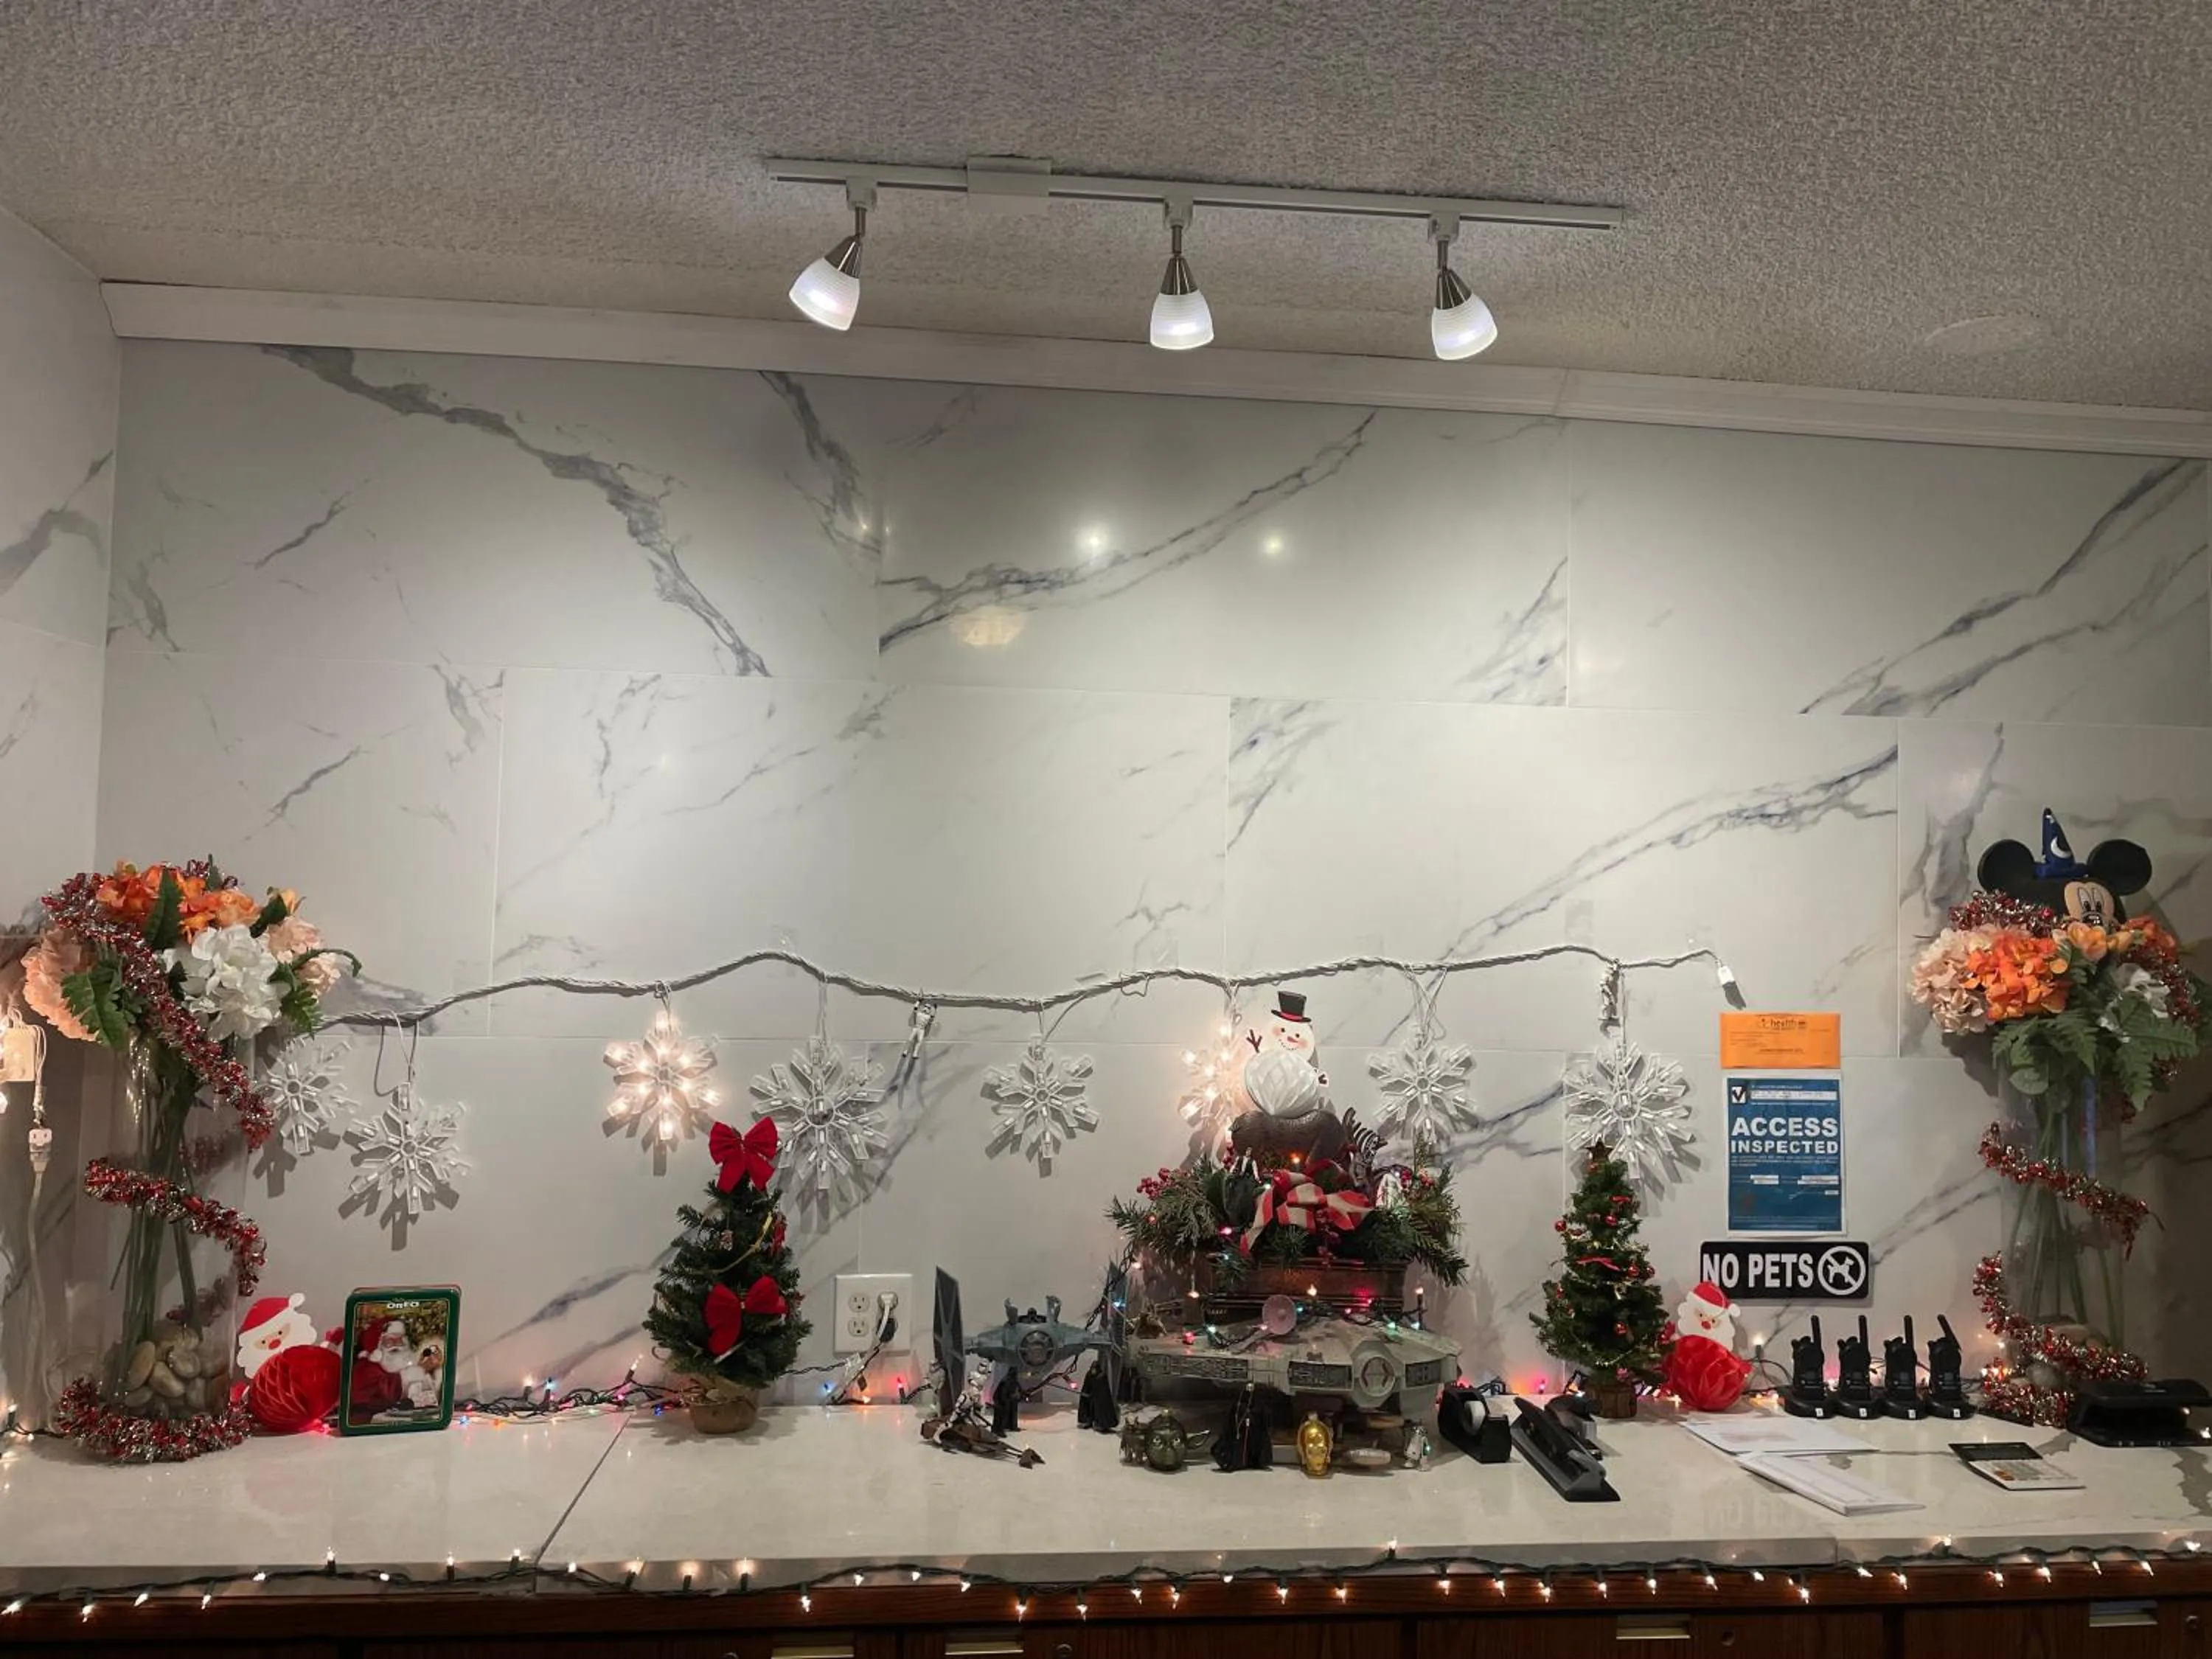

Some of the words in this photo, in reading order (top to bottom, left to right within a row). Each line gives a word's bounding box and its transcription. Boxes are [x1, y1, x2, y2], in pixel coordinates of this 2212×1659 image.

[1731, 1117, 1838, 1137] ACCESS
[1731, 1140, 1838, 1154] INSPECTED
[1703, 1253, 1739, 1288] NO
[1748, 1253, 1814, 1288] PETS
